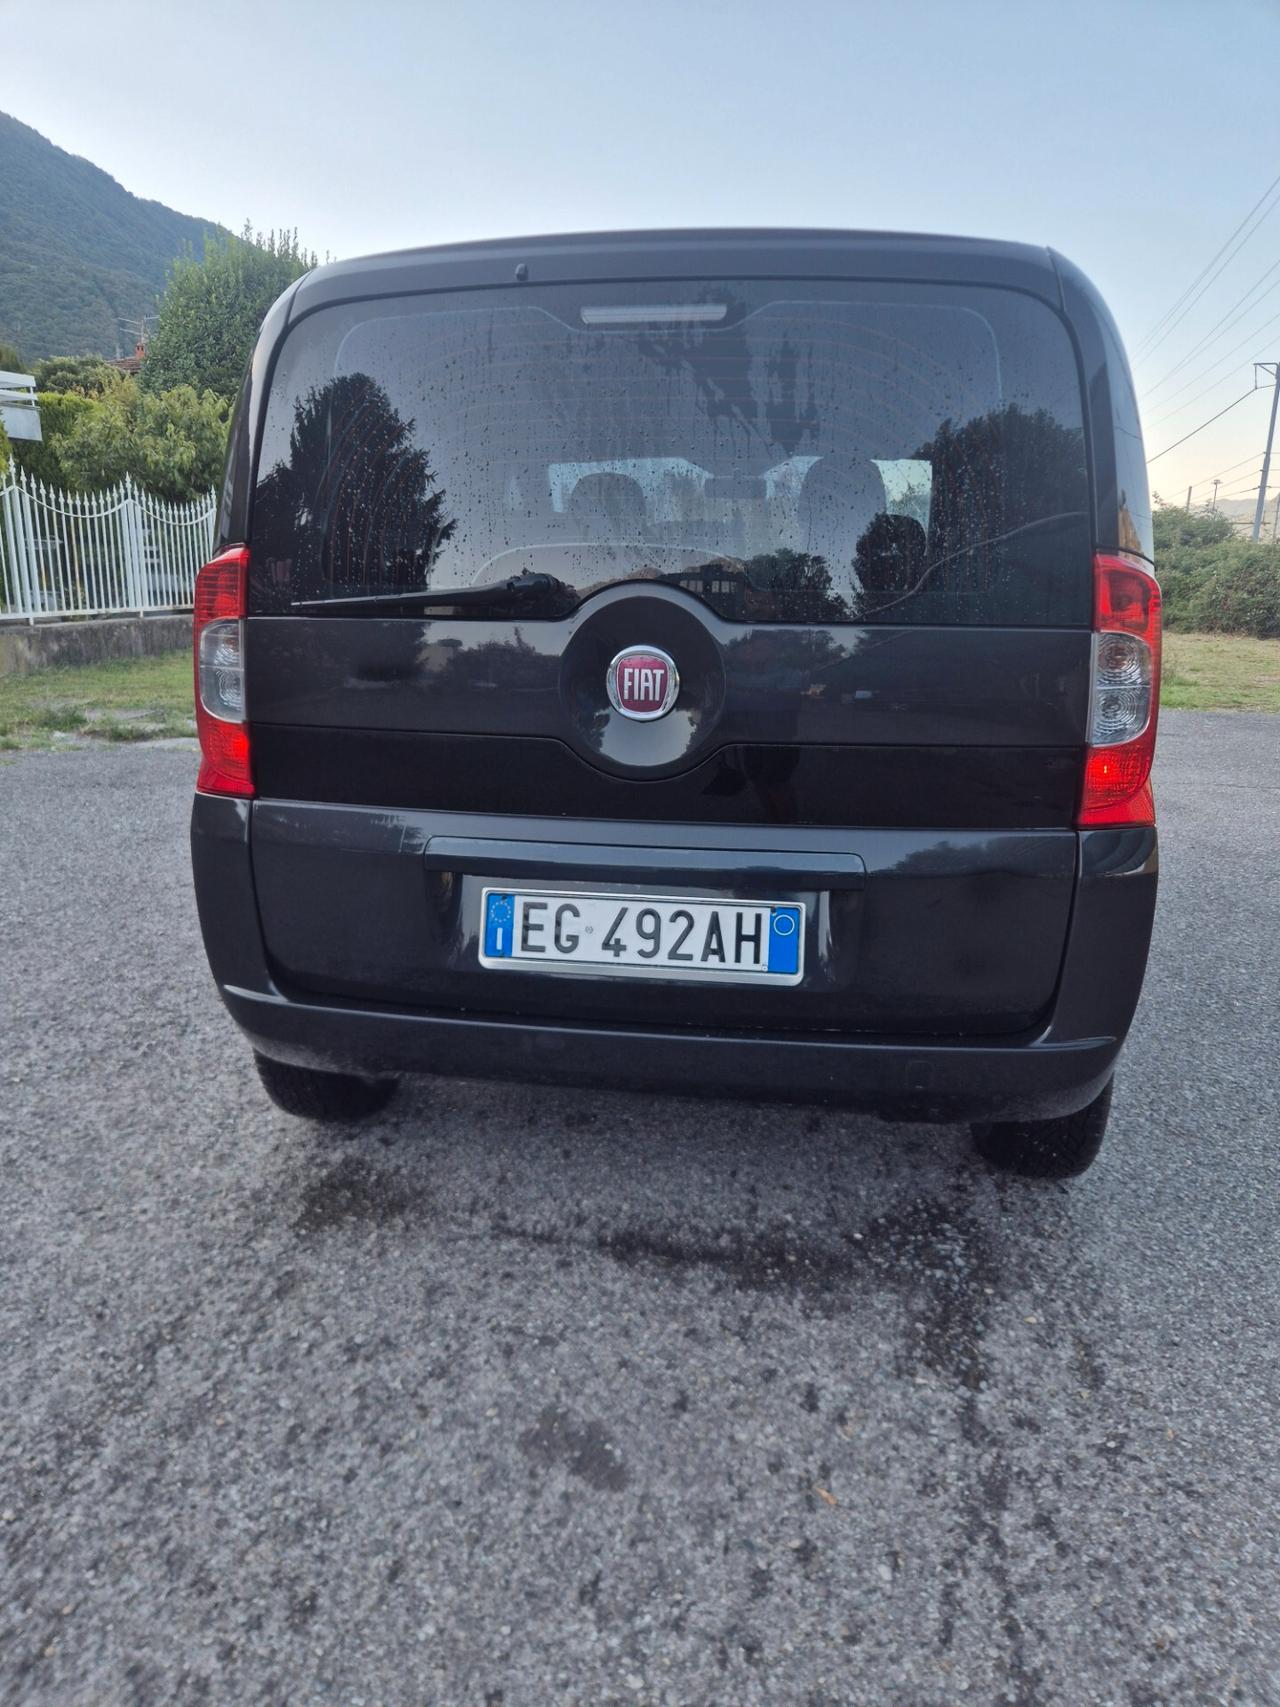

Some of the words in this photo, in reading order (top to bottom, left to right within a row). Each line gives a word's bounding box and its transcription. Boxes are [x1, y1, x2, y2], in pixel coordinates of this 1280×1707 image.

[623, 668, 664, 701] FIAT
[520, 901, 580, 954] EG
[601, 906, 763, 965] 492AH
